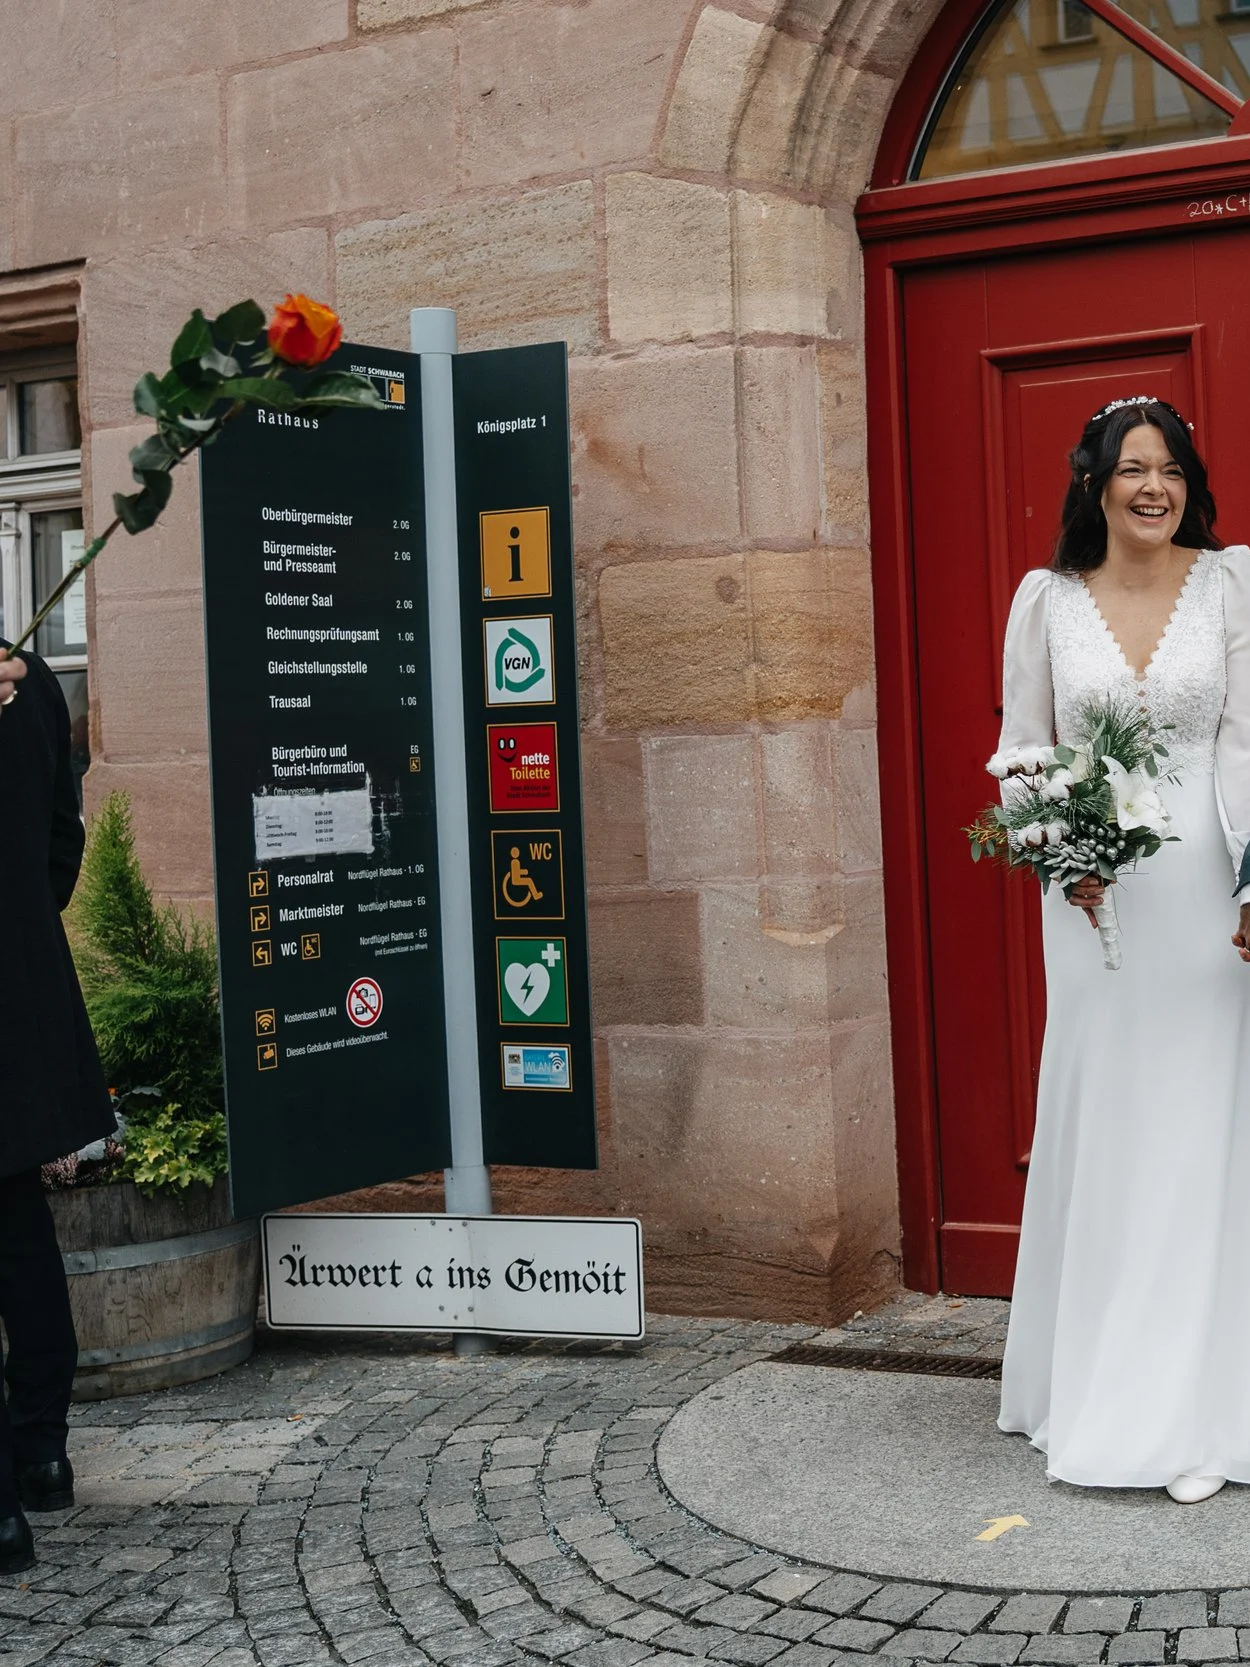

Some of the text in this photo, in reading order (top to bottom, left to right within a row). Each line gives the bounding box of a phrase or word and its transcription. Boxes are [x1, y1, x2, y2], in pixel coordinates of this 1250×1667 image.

[350, 365, 405, 379] STADT SCHWABACH
[258, 409, 319, 429] Rathaus
[477, 415, 546, 434] Königsplatz 1
[262, 507, 353, 525] Oberbürgermeister
[263, 541, 336, 557] Bürgermeister-
[264, 559, 337, 573] und Presseamt
[265, 592, 333, 607] Goldener Saal
[267, 627, 380, 643] Rechnungsprüfungsamt
[268, 661, 368, 676] Gleichstellungsstelle
[504, 657, 531, 670] VGN
[269, 695, 311, 708] Trausaal
[272, 744, 347, 762] Bürgerbüro und
[410, 745, 419, 754] EG
[521, 752, 550, 765] nette
[272, 761, 365, 777] Tourist-Information
[510, 766, 551, 780] Toilette
[529, 842, 552, 860] WC
[277, 869, 334, 888] Personalrat
[379, 867, 403, 877] Rathaus
[279, 903, 344, 922] Marktmeister
[389, 899, 413, 909] Rathaus
[417, 896, 426, 906] EG
[391, 931, 414, 942] Rathaus
[418, 928, 428, 939] EG
[280, 941, 297, 957] WC
[284, 1006, 337, 1023] Kostenloses WLAN
[286, 1031, 389, 1058] Dieses Gebäude wird videoüberwacht.
[278, 1244, 627, 1296] Ärwert a ins Gemöit
